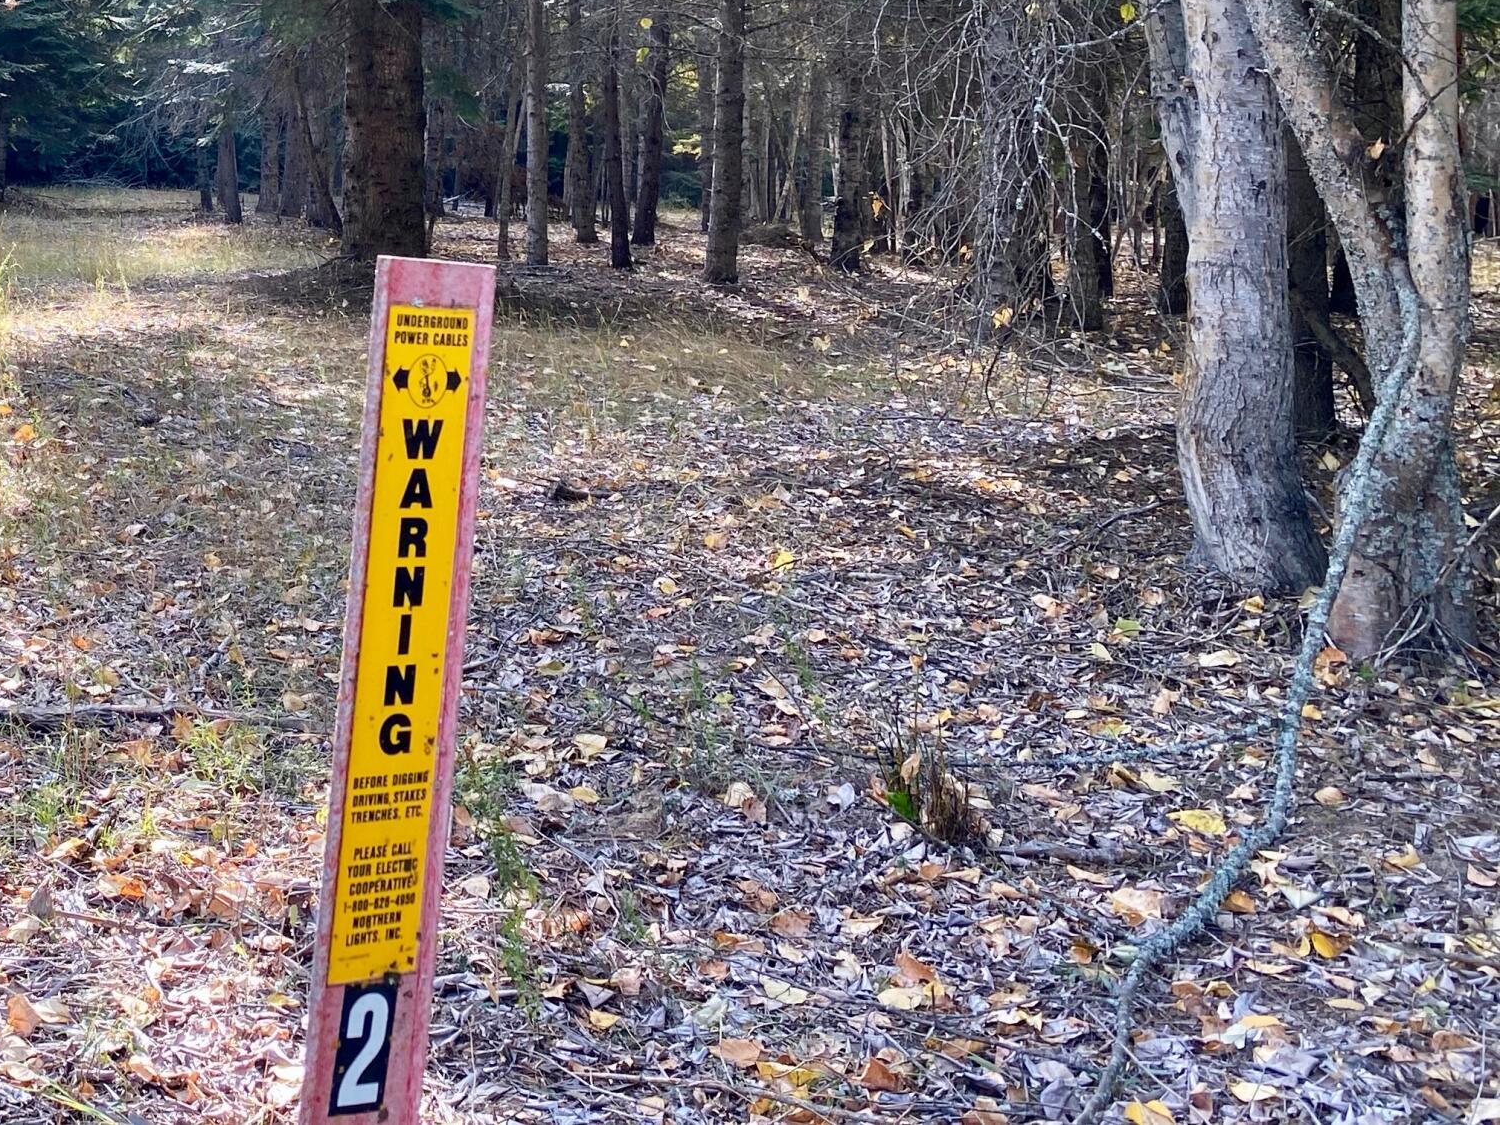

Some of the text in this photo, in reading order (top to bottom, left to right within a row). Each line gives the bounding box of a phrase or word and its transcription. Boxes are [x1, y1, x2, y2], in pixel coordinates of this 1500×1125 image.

[396, 314, 469, 330] UNDERGROUND
[394, 331, 469, 347] POWER CABLES
[379, 418, 444, 756] WARNING
[352, 770, 429, 790] BEFORE DIGGING
[393, 788, 427, 803] STAKES
[353, 842, 412, 860] PLEASE CALL
[347, 858, 418, 878] YOUR ELECTC
[352, 911, 402, 930] NORTHERN
[336, 992, 389, 1107] 2
